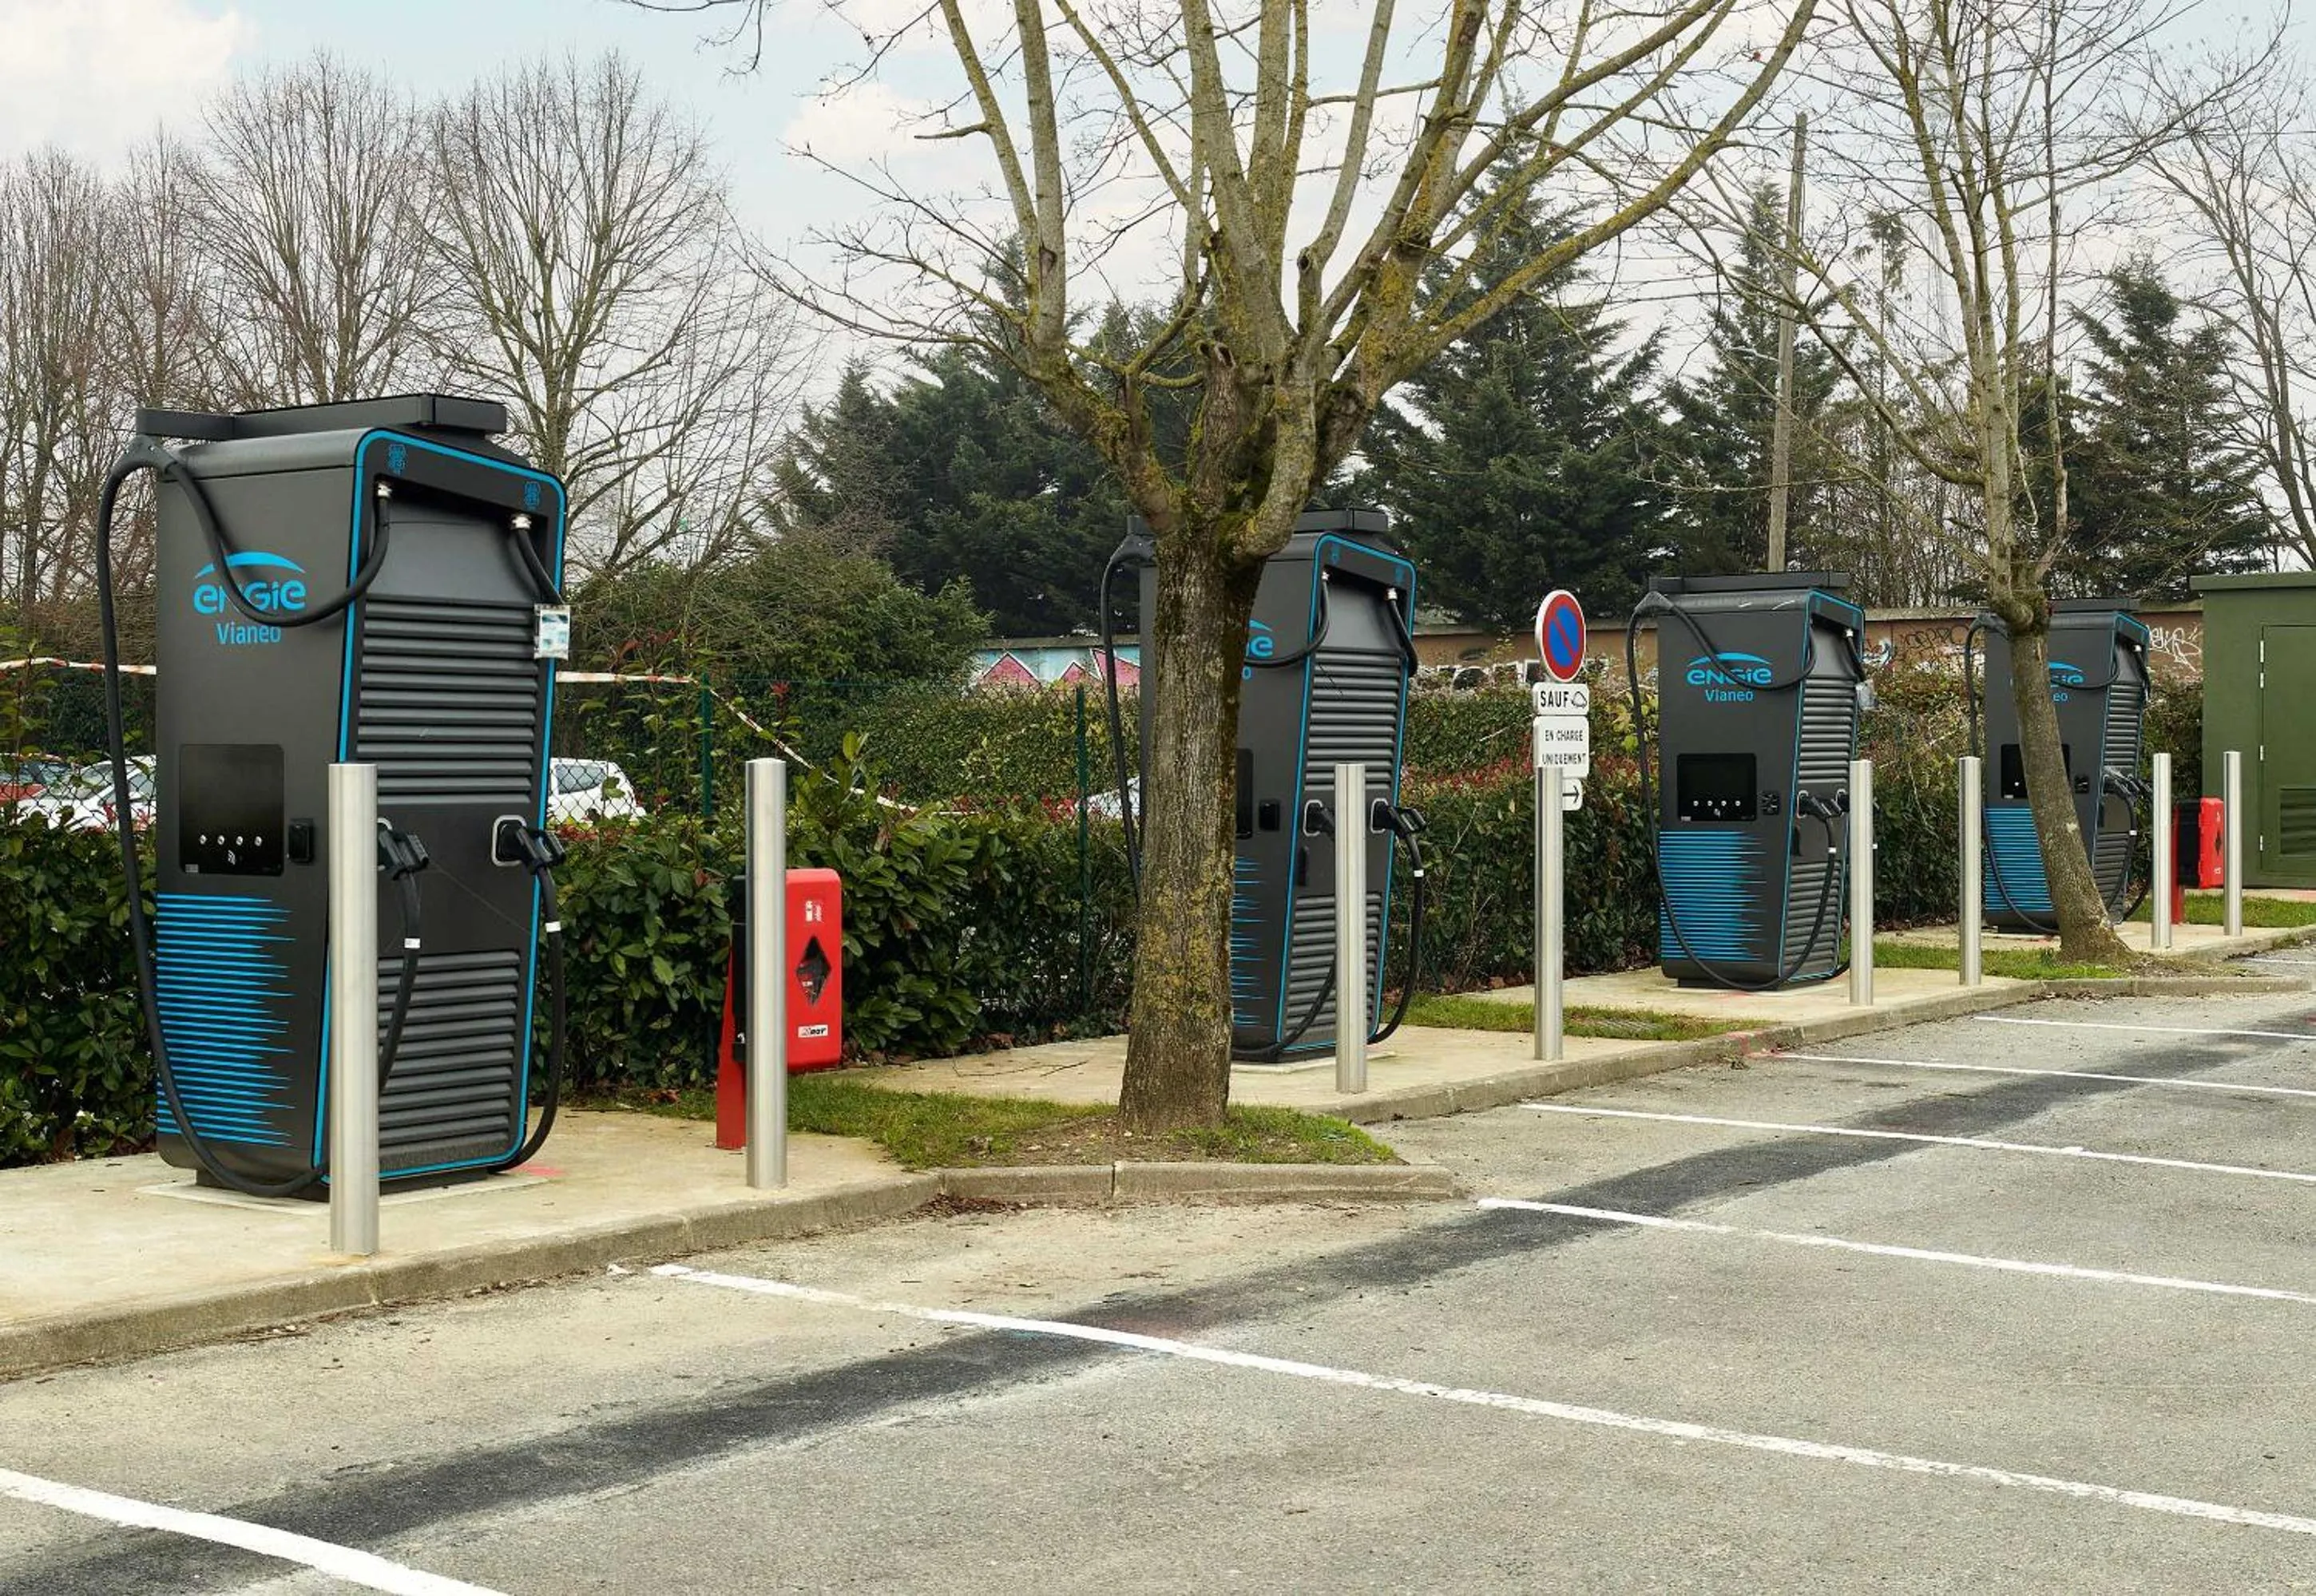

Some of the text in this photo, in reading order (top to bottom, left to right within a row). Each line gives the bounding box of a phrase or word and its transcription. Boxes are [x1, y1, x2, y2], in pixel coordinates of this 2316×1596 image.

[216, 620, 282, 645] Vianeo
[1540, 691, 1569, 708] SAUF
[1704, 689, 1754, 702] Vianeo
[1545, 729, 1584, 742] EN CHARGE
[1541, 753, 1587, 765] UNIQUEMENT
